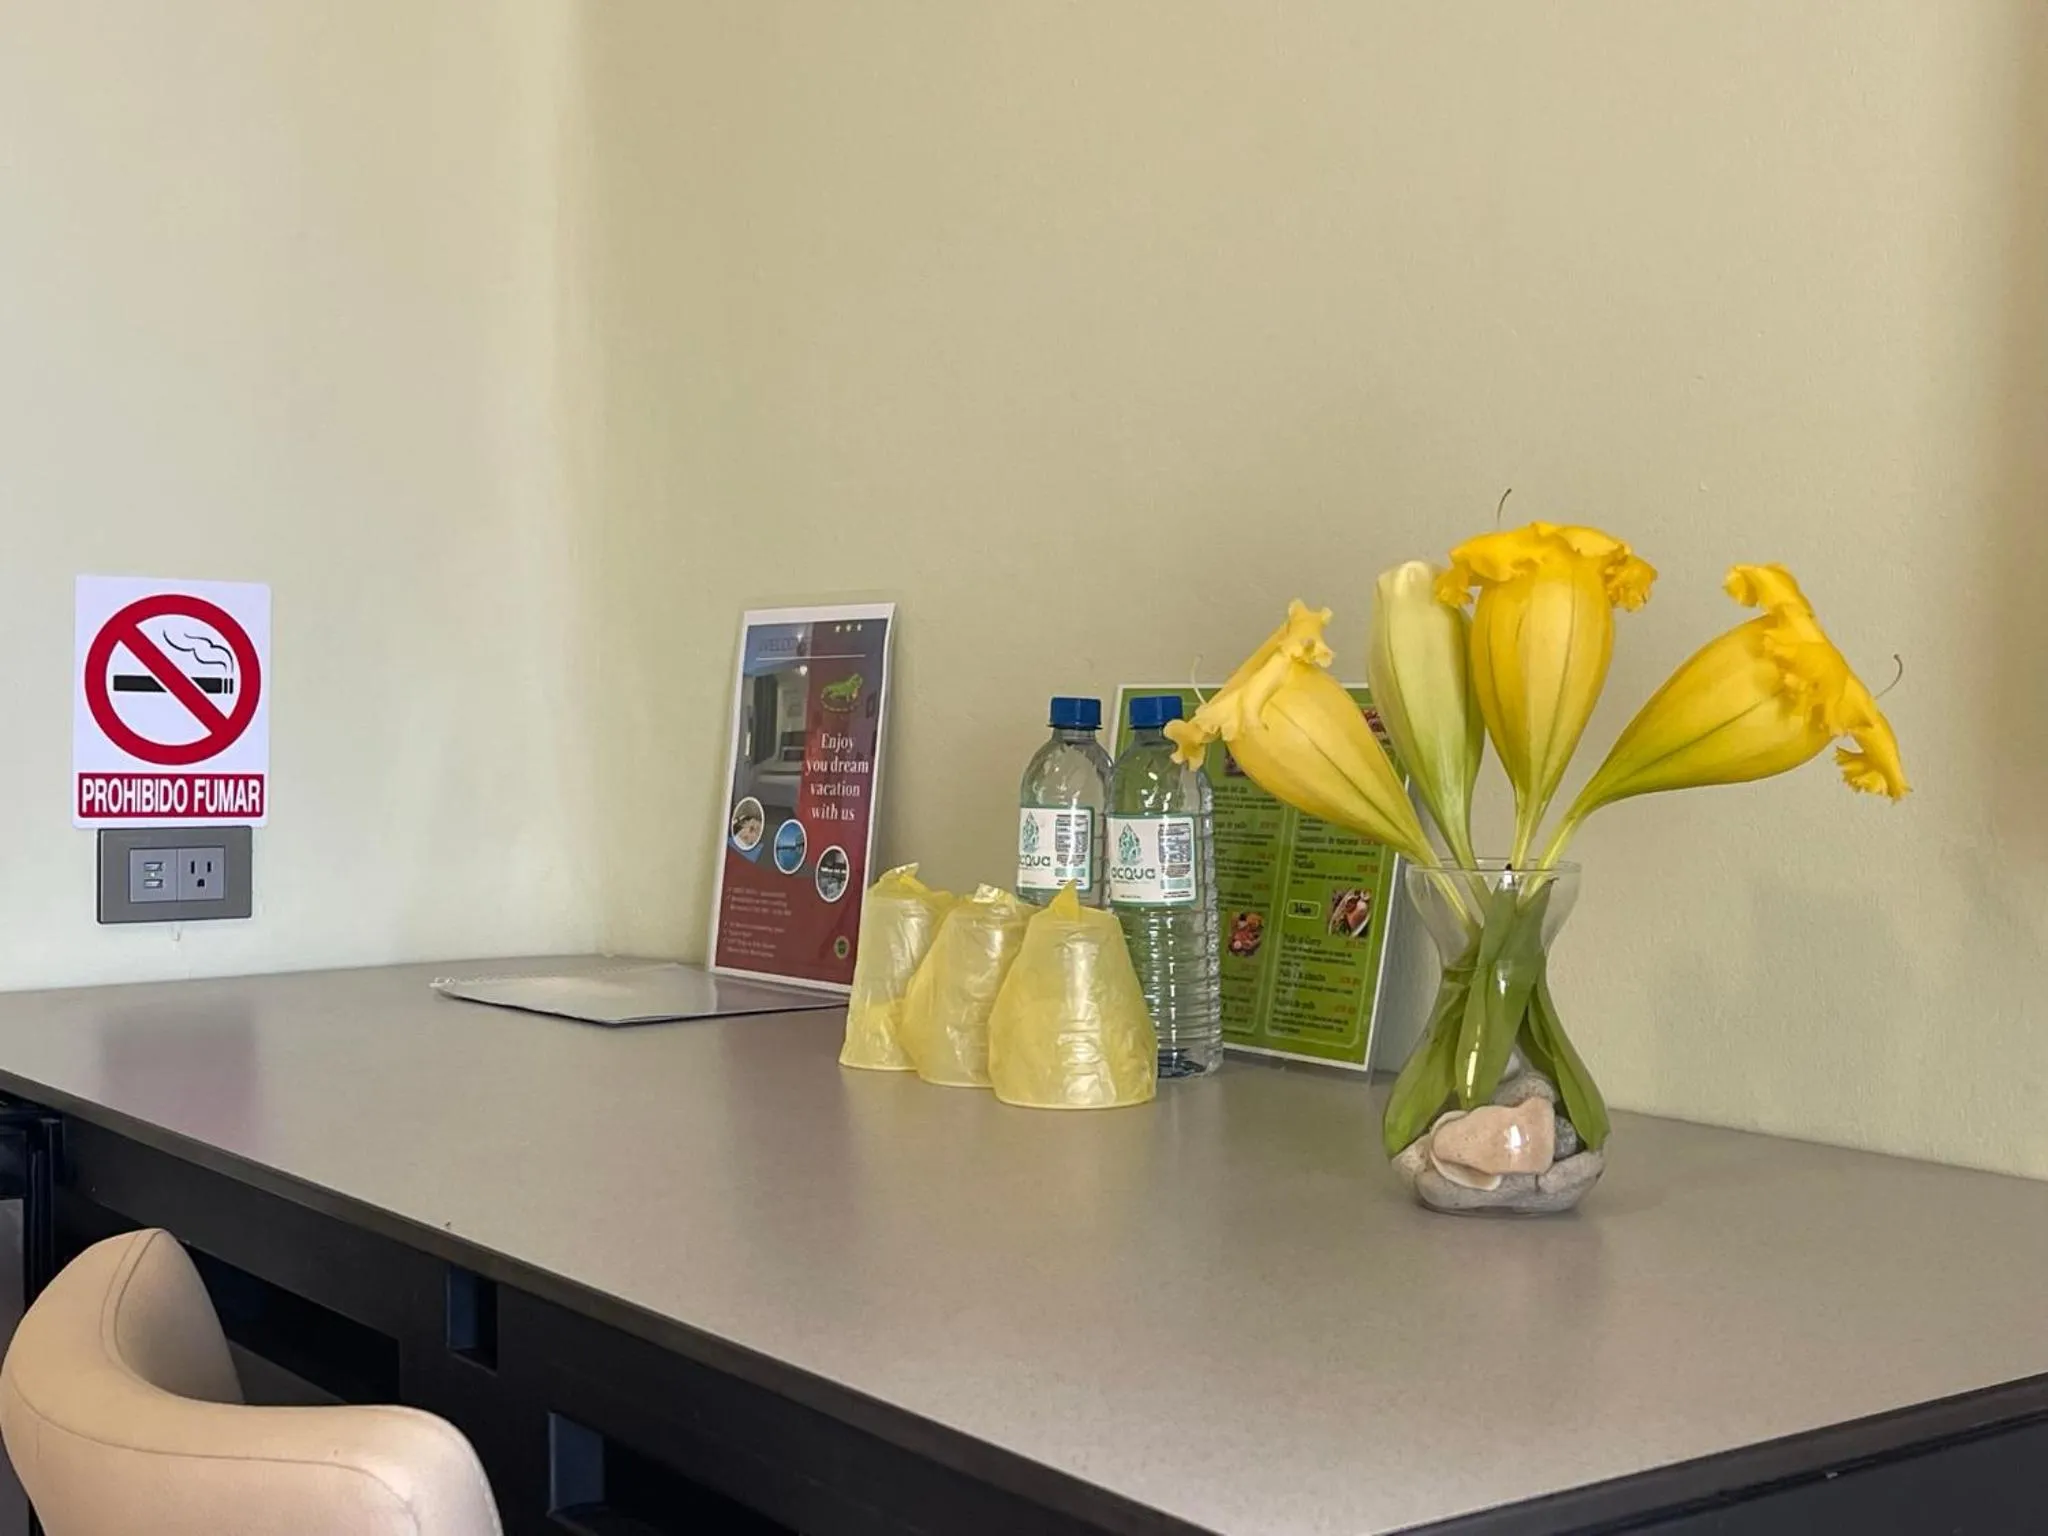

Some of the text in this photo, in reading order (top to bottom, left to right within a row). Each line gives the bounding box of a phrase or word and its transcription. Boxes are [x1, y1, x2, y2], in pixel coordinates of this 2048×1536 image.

[821, 733, 854, 753] Enjoy
[805, 755, 869, 776] you dream
[82, 778, 261, 813] PROHIBIDO FUMAR
[810, 780, 861, 797] vacation
[811, 803, 855, 820] with us
